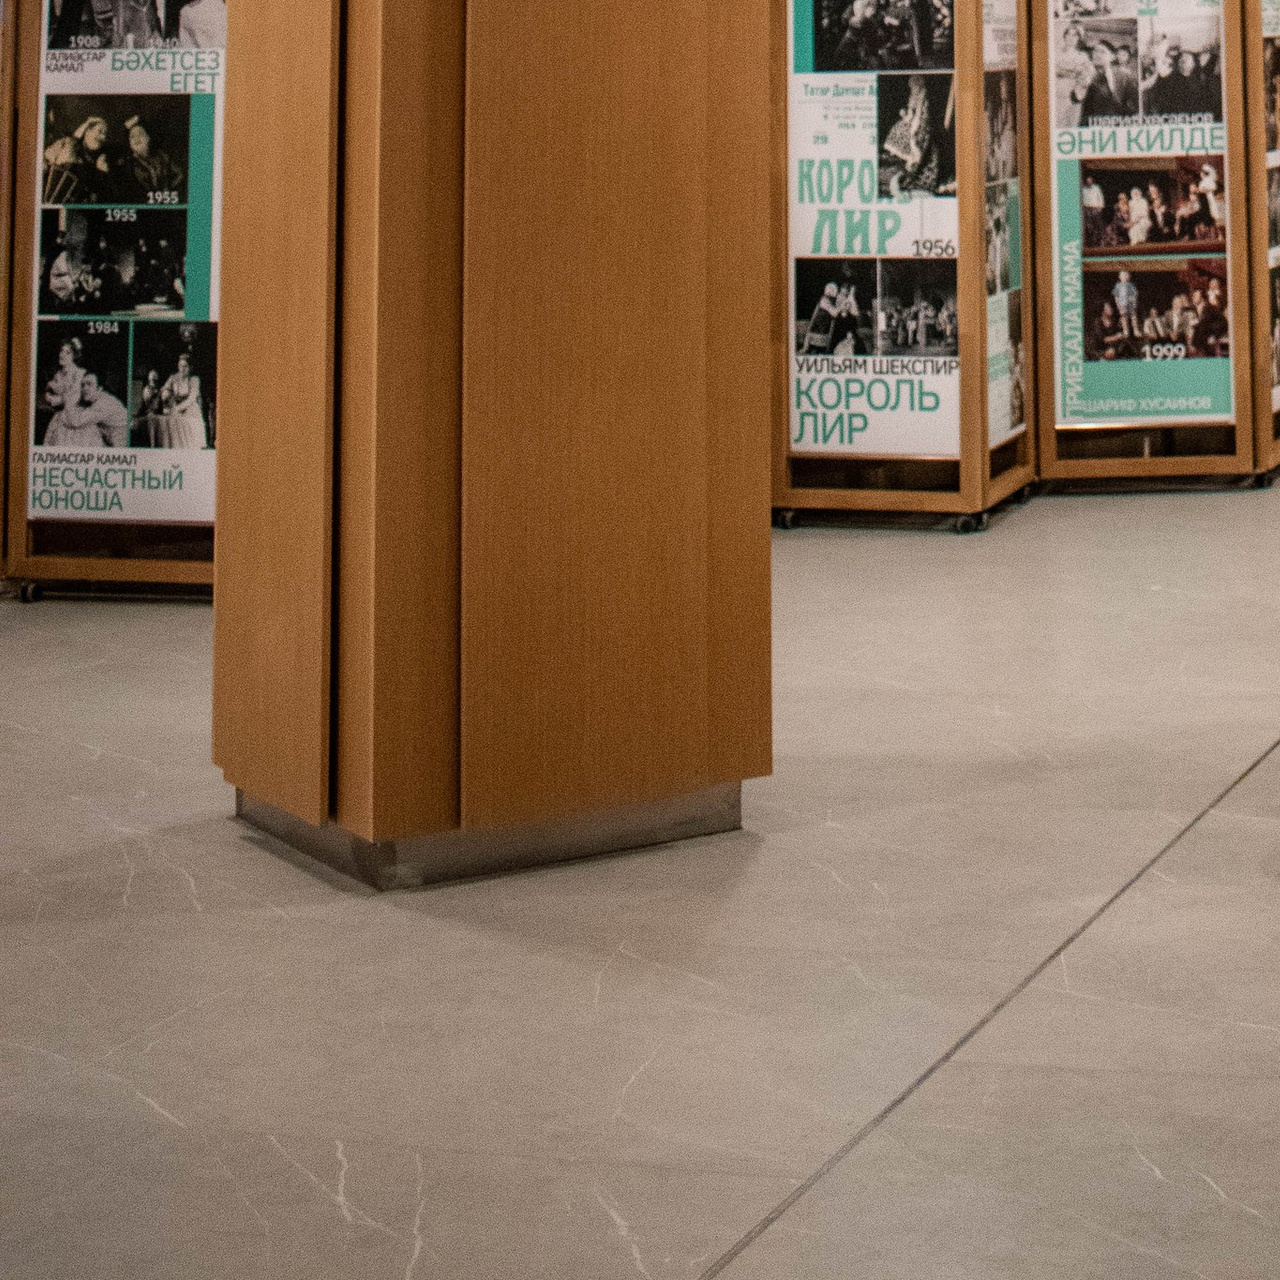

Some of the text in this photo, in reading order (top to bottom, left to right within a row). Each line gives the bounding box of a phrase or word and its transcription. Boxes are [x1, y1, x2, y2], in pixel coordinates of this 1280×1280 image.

[111, 49, 220, 72] БӘХЕТСЕЗ
[170, 72, 220, 93] ЕГЕТ
[1057, 126, 1226, 156] ӘНИ КИЛДЕ
[146, 191, 179, 204] 1955
[105, 209, 137, 222] 1955
[811, 208, 903, 255] ЛИР
[911, 239, 956, 258] 1956
[87, 321, 119, 334] 1984
[1062, 240, 1085, 417] ПРИЕХАЛА МАМА
[1140, 342, 1186, 362] 1999
[795, 357, 960, 376] УИЛЬЯМ ШЕКСПИР
[795, 377, 941, 413] КОРОЛЬ
[794, 411, 869, 445] ЛИР
[32, 452, 137, 466] ГАЛИАСГАР КАМАЛ
[32, 464, 183, 490] НЕСЧАСТНЫЙ
[32, 489, 124, 512] ЮНОША
